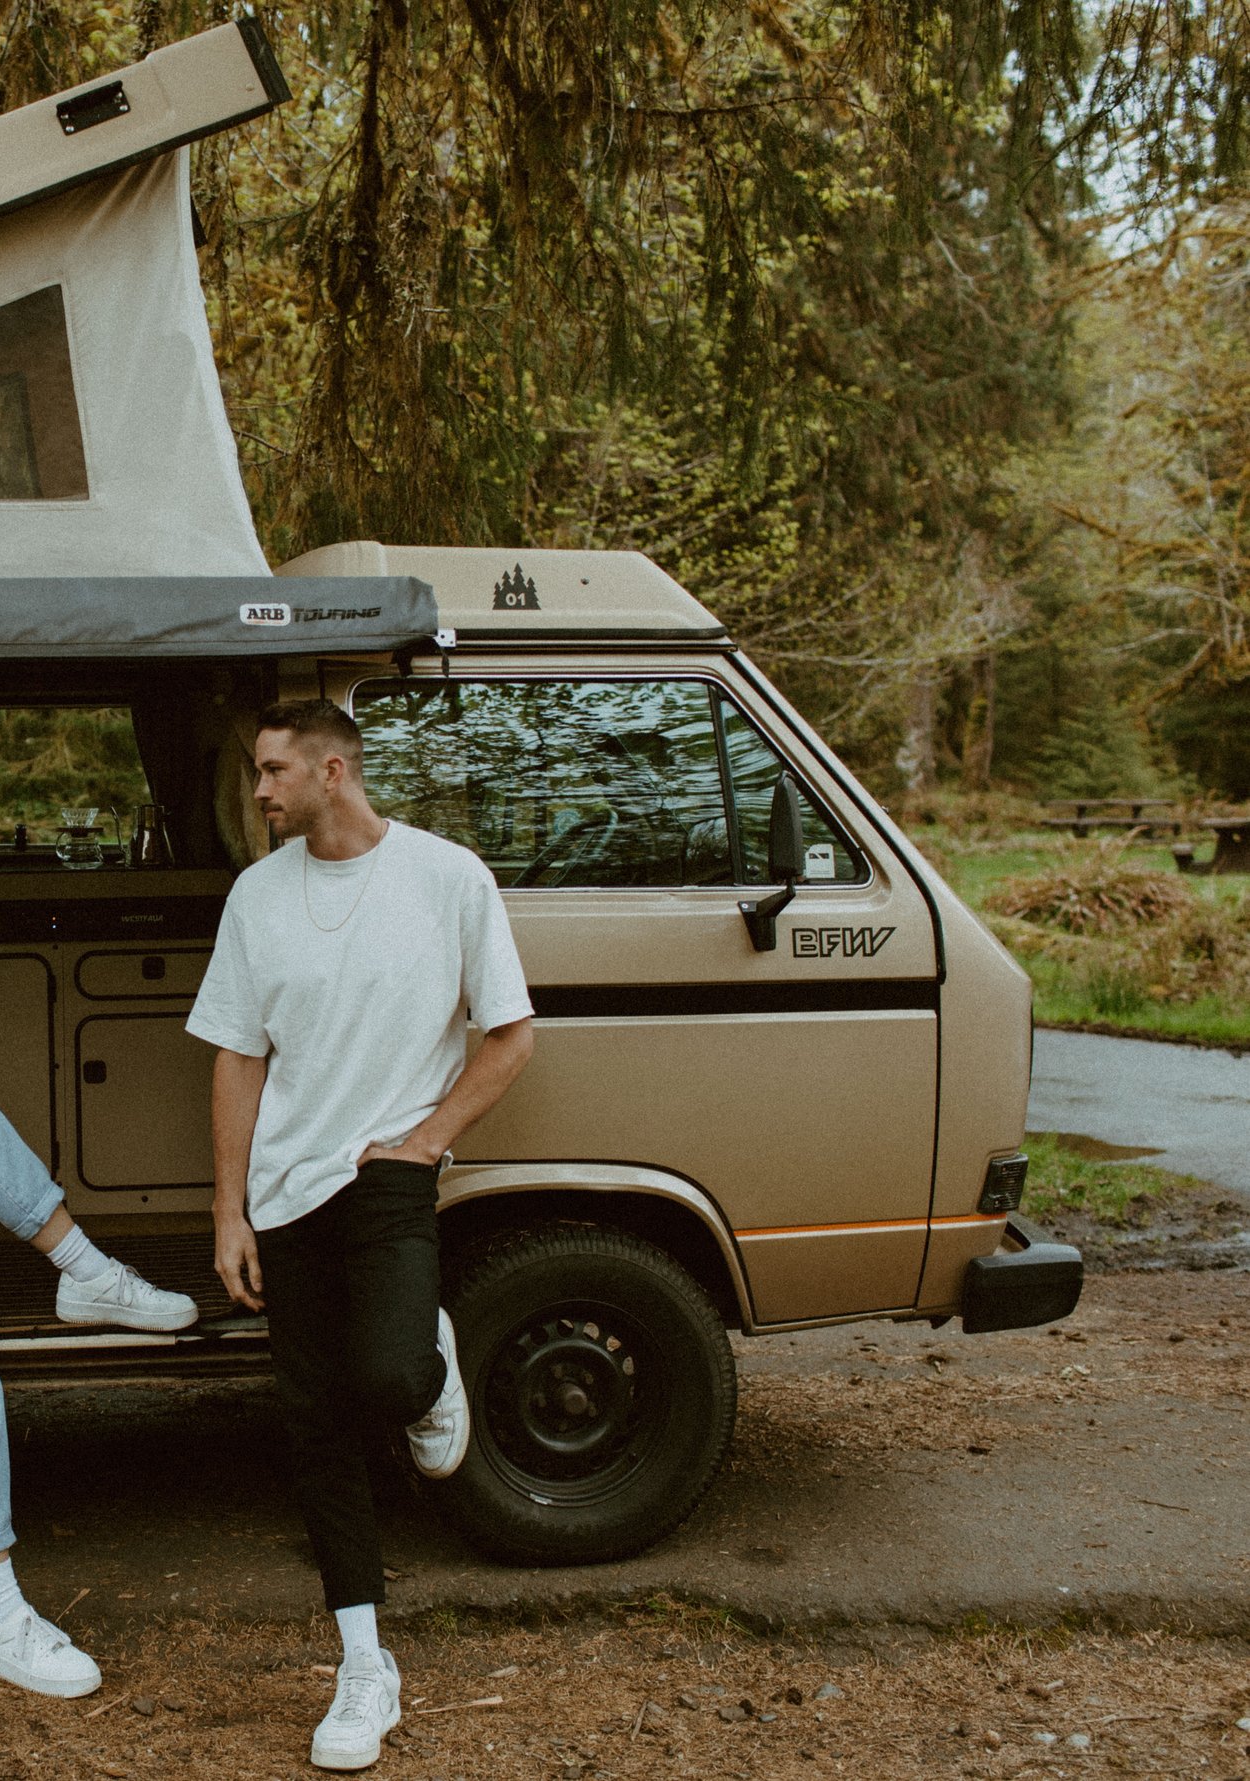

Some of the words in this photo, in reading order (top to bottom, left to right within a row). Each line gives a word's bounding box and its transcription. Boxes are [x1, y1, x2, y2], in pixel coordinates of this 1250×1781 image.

[506, 592, 526, 606] 01
[246, 608, 285, 621] ARB
[292, 607, 382, 623] TOURING
[792, 926, 897, 958] BFW
